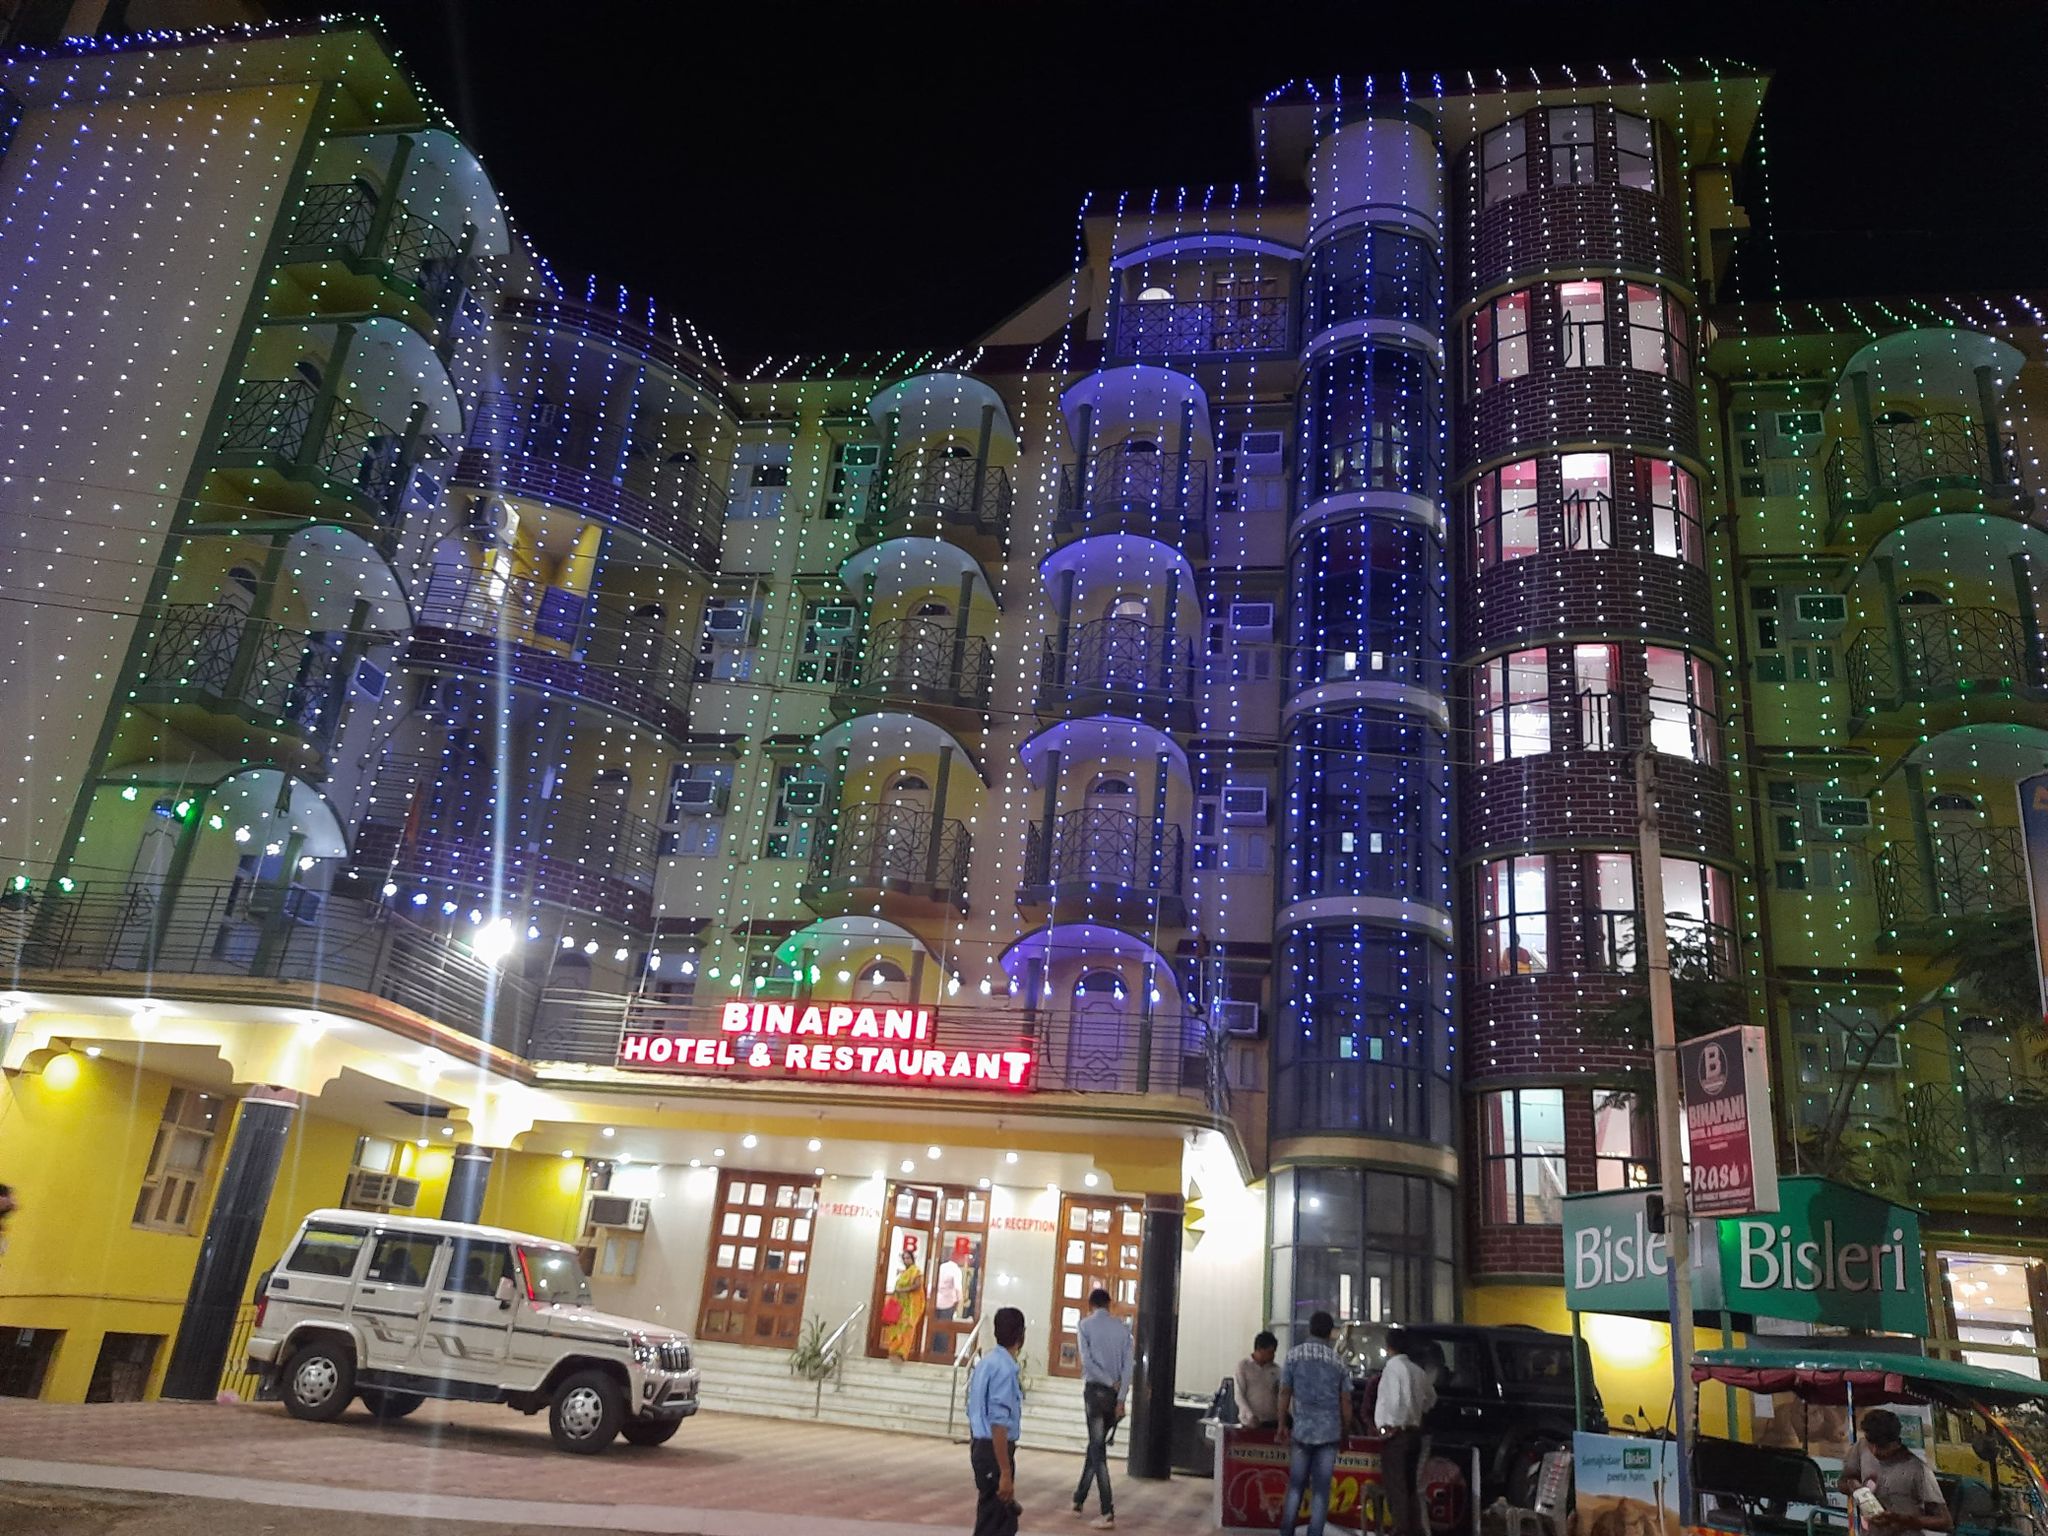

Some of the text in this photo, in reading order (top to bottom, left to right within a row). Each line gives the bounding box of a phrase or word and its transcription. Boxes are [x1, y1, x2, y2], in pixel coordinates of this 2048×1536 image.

[722, 1002, 928, 1039] BINAPANI
[624, 1036, 1031, 1084] HOTEL & RESTAURANT
[1704, 1046, 1721, 1080] B
[1689, 1094, 1746, 1129] BINAPANI
[990, 1217, 1056, 1233] AC RECEPTION
[903, 1235, 918, 1253] B
[1574, 1211, 1702, 1290] Bislei
[1738, 1219, 1906, 1292] Bisleri
[1625, 1451, 1649, 1465] Bisleri
